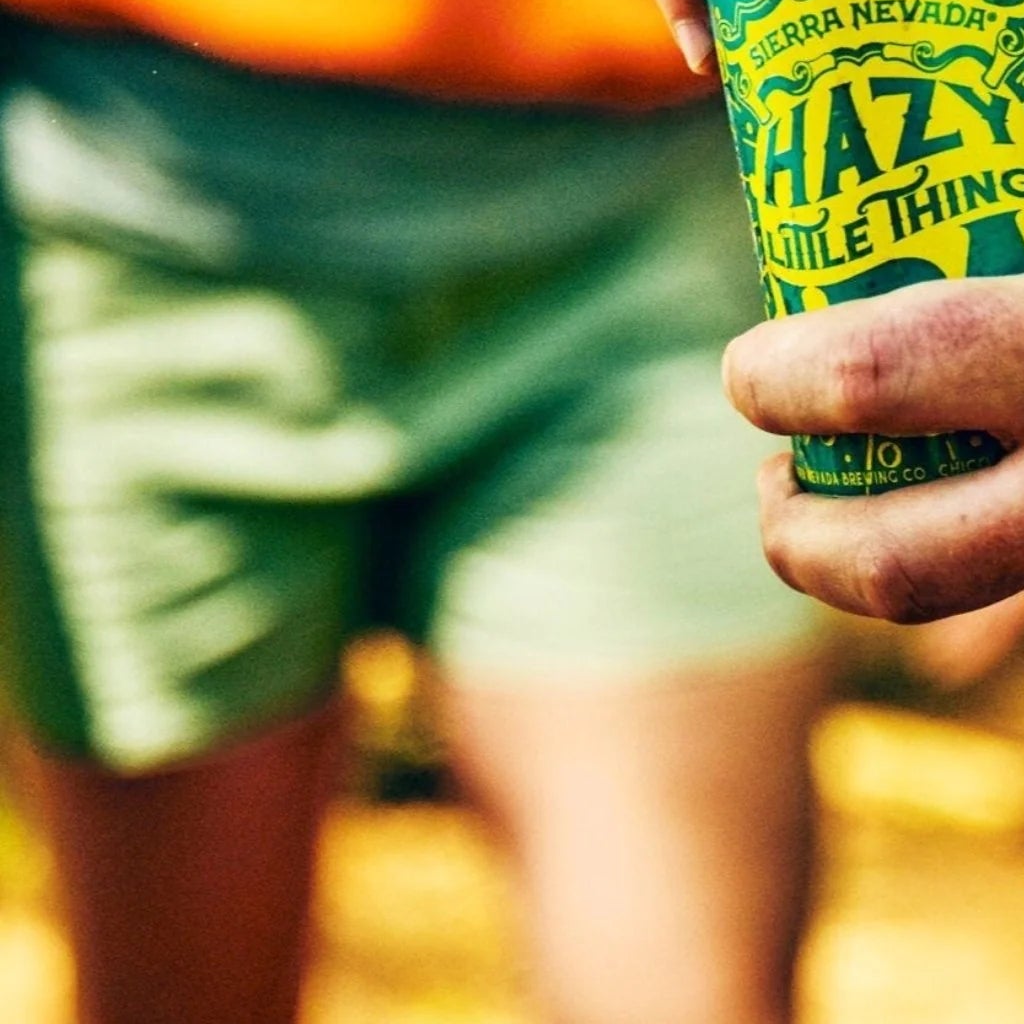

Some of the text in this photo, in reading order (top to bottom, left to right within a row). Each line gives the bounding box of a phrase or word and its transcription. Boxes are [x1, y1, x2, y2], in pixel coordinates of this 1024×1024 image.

[748, 7, 845, 68] SIERRA
[765, 77, 1016, 207] HAZY
[767, 207, 874, 270] LITTLE
[841, 470, 898, 487] BREWING
